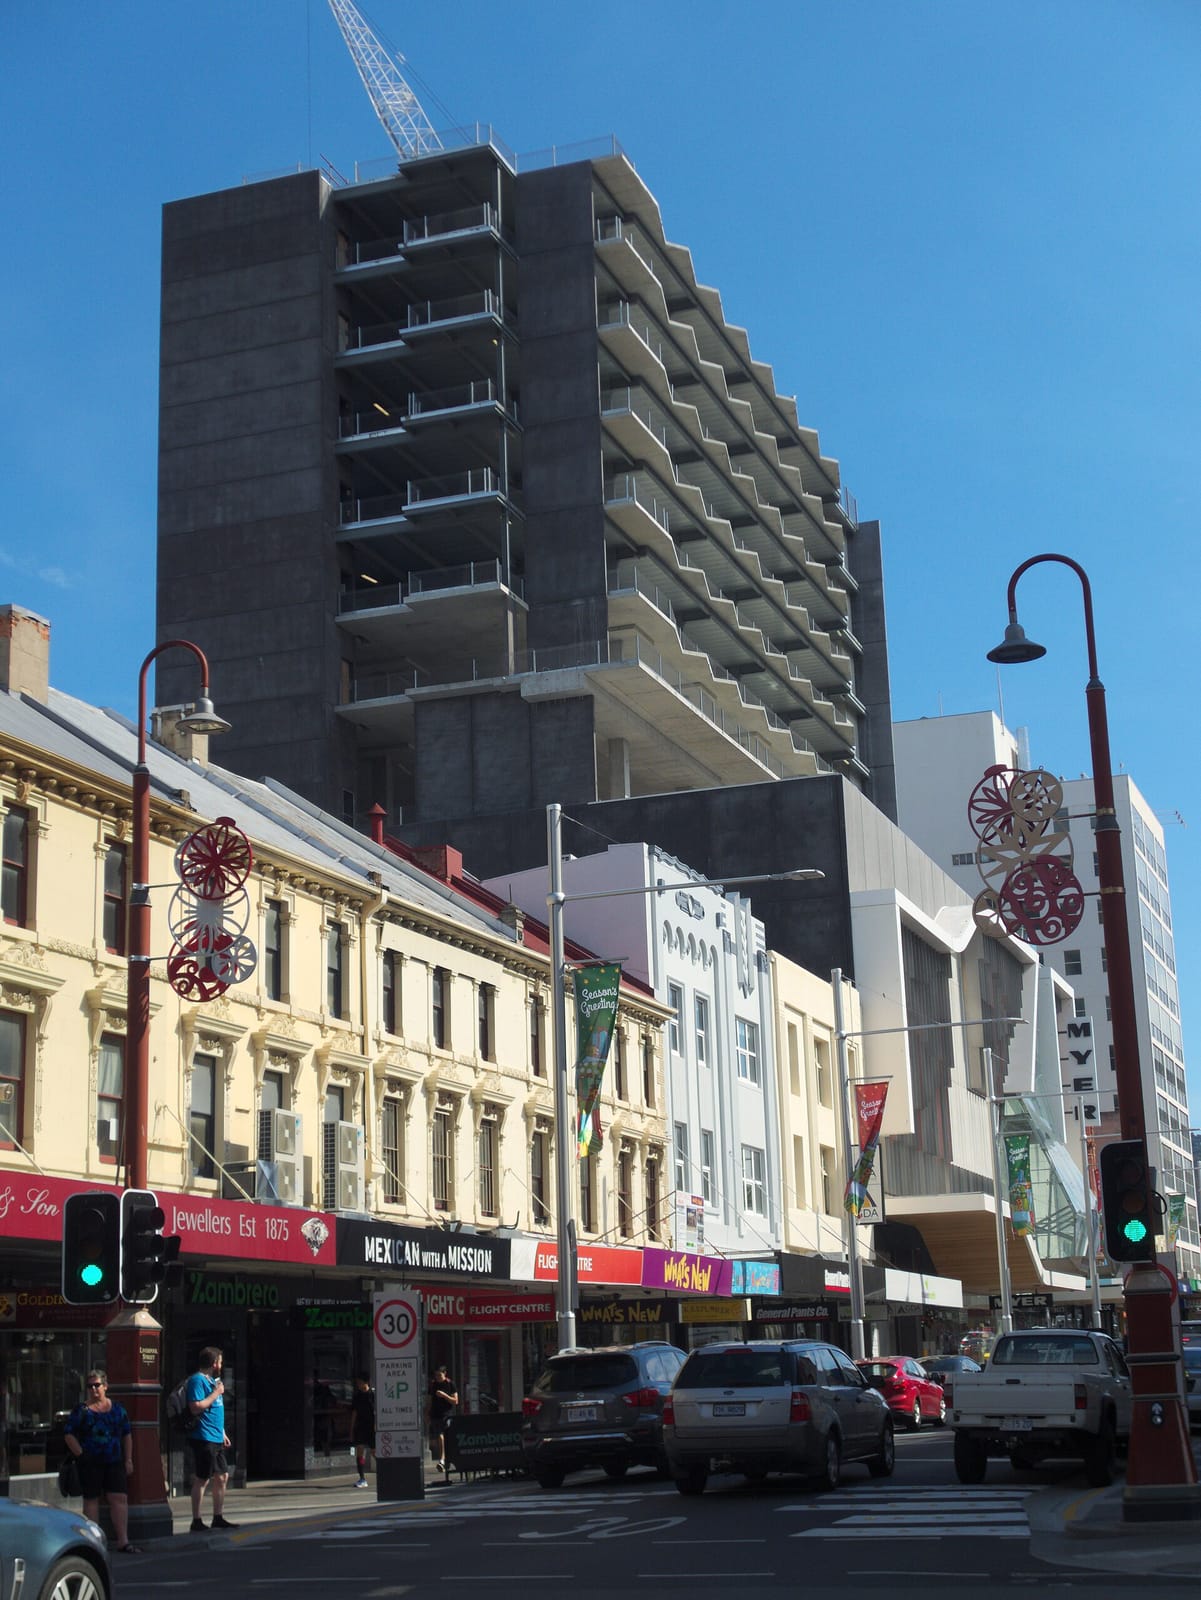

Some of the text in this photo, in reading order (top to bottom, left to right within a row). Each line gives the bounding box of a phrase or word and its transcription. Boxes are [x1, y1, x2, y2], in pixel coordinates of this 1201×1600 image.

[581, 986, 618, 1001] Season's
[1067, 1022, 1097, 1121] MYER
[20, 1188, 60, 1217] Son
[171, 1206, 289, 1241] Jewellers Est 1875
[365, 1236, 492, 1273] MEXICAN WITH A MISSION
[538, 1254, 558, 1269] FLIGH
[191, 1272, 278, 1306] Zambrero
[304, 1306, 373, 1328] Zambr
[470, 1305, 508, 1315] FLIGHT
[509, 1303, 551, 1313] CENTRE
[756, 1307, 790, 1319] General
[791, 1306, 815, 1317] Pants
[383, 1313, 410, 1335] 30
